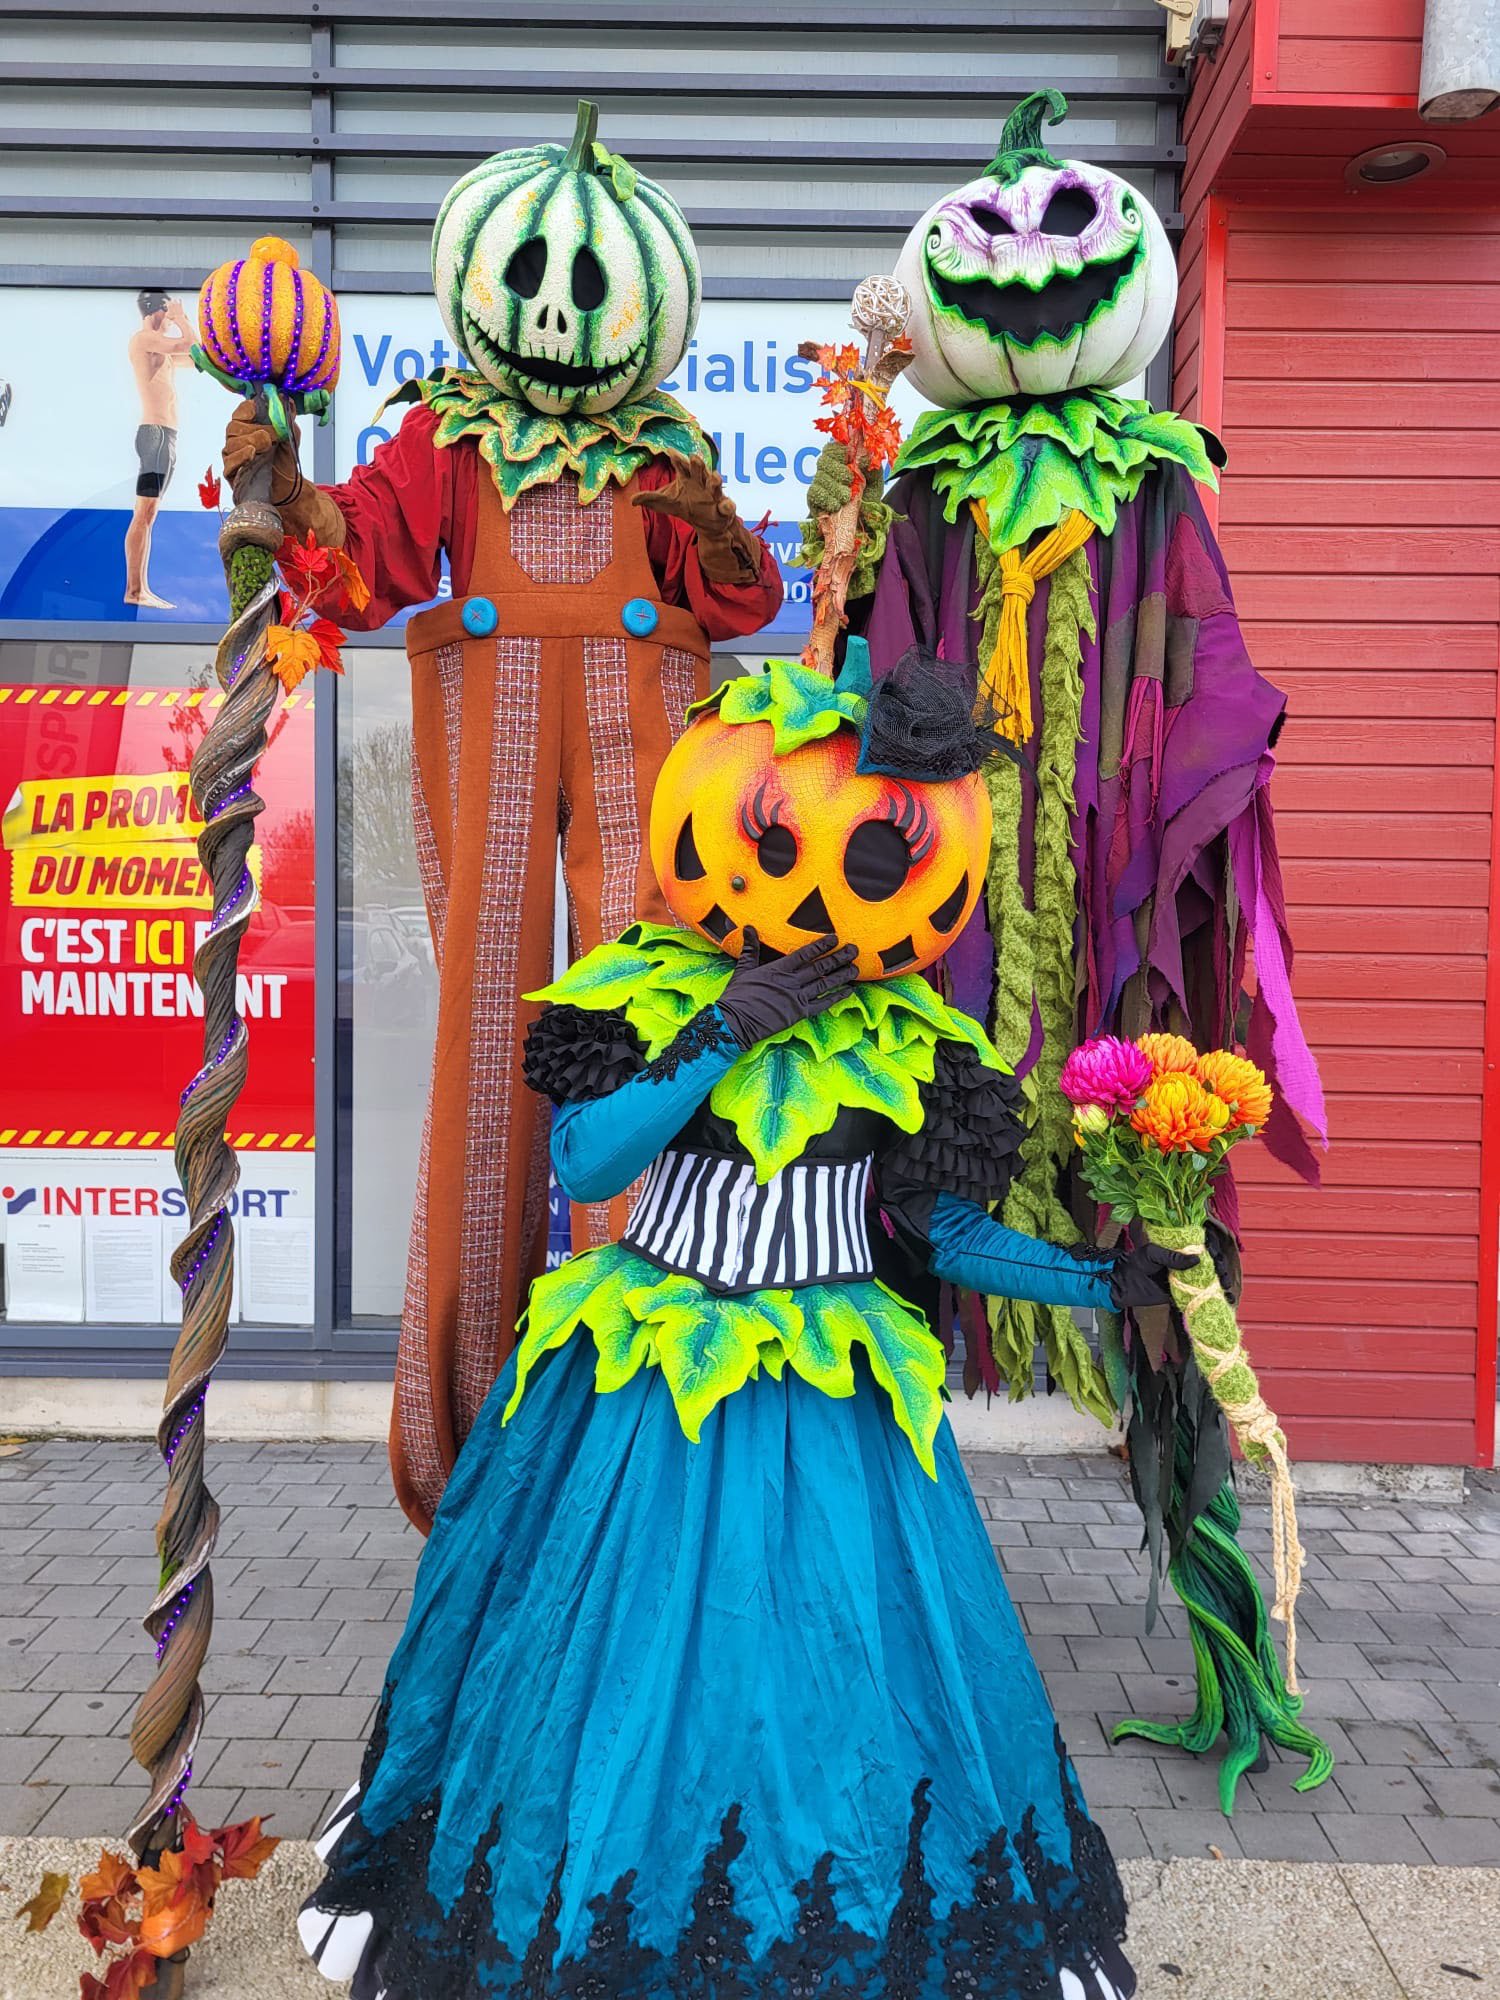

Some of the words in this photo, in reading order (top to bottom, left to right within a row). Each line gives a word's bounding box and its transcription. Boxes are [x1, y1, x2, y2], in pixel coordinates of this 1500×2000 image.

[31, 792, 76, 835] LA
[28, 856, 86, 896] DU
[20, 918, 130, 965] C'EST
[134, 919, 185, 966] ICI
[21, 970, 288, 1019] MAINTENNT
